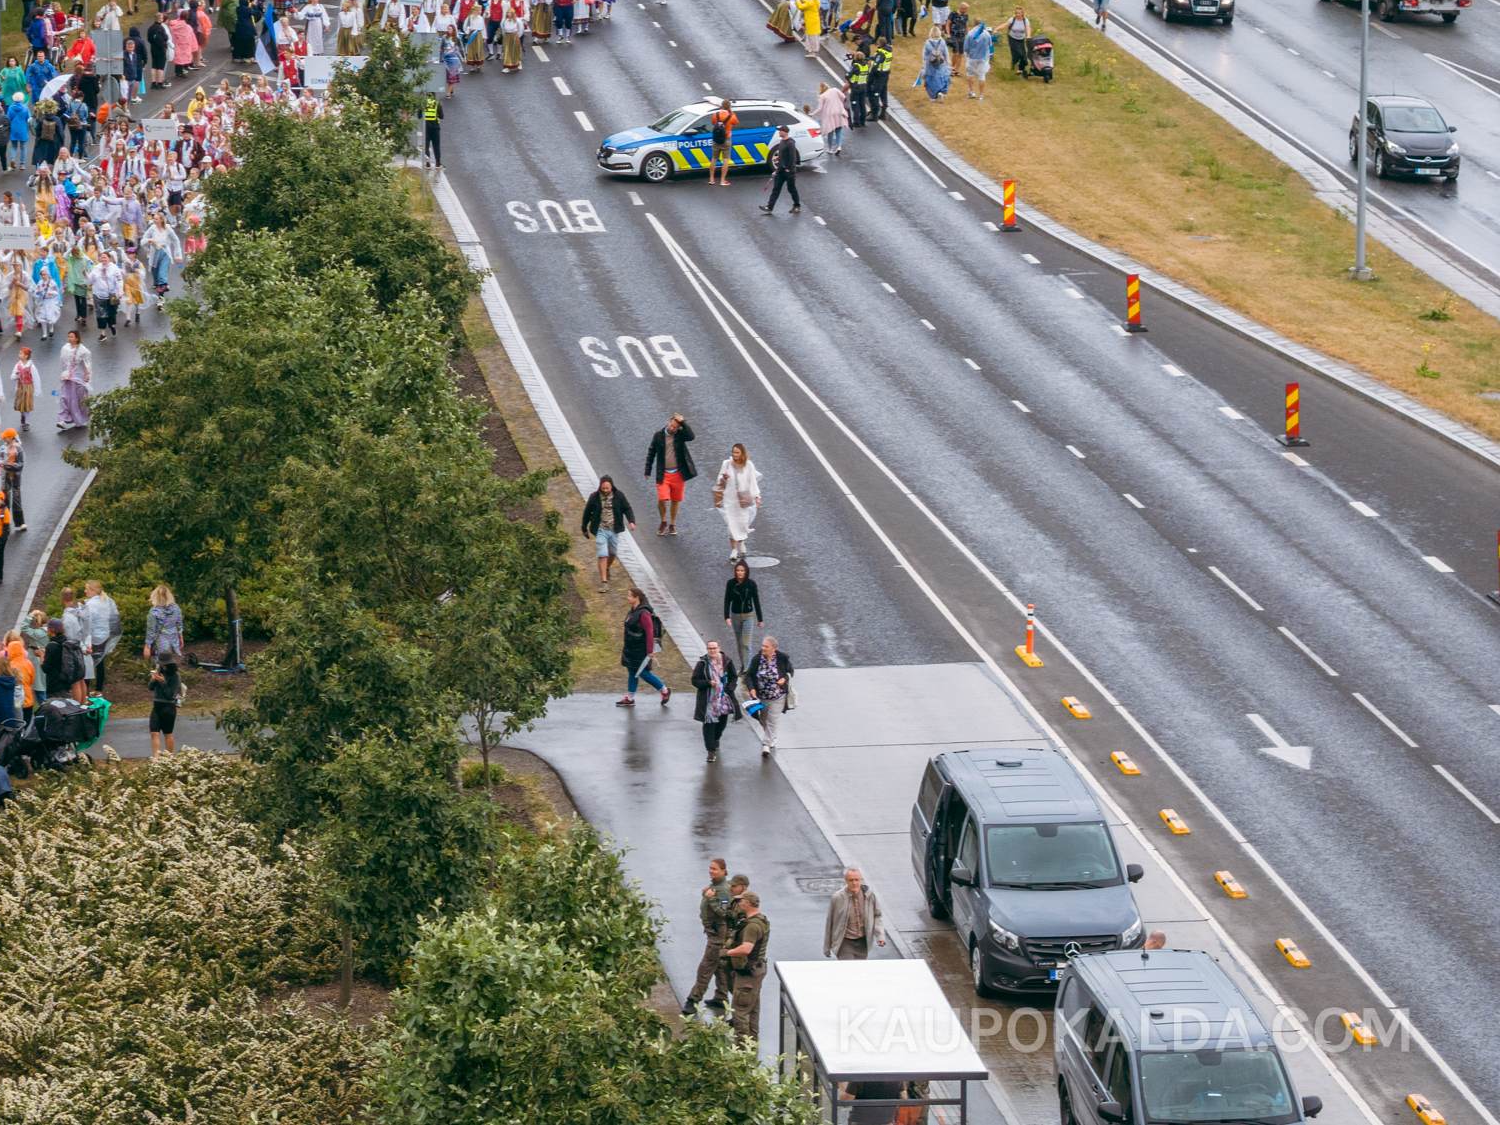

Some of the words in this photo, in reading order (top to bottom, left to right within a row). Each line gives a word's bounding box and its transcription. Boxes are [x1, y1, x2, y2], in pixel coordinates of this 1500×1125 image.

[678, 138, 713, 149] POLITSE
[506, 199, 607, 233] BUS
[579, 335, 699, 377] BUS
